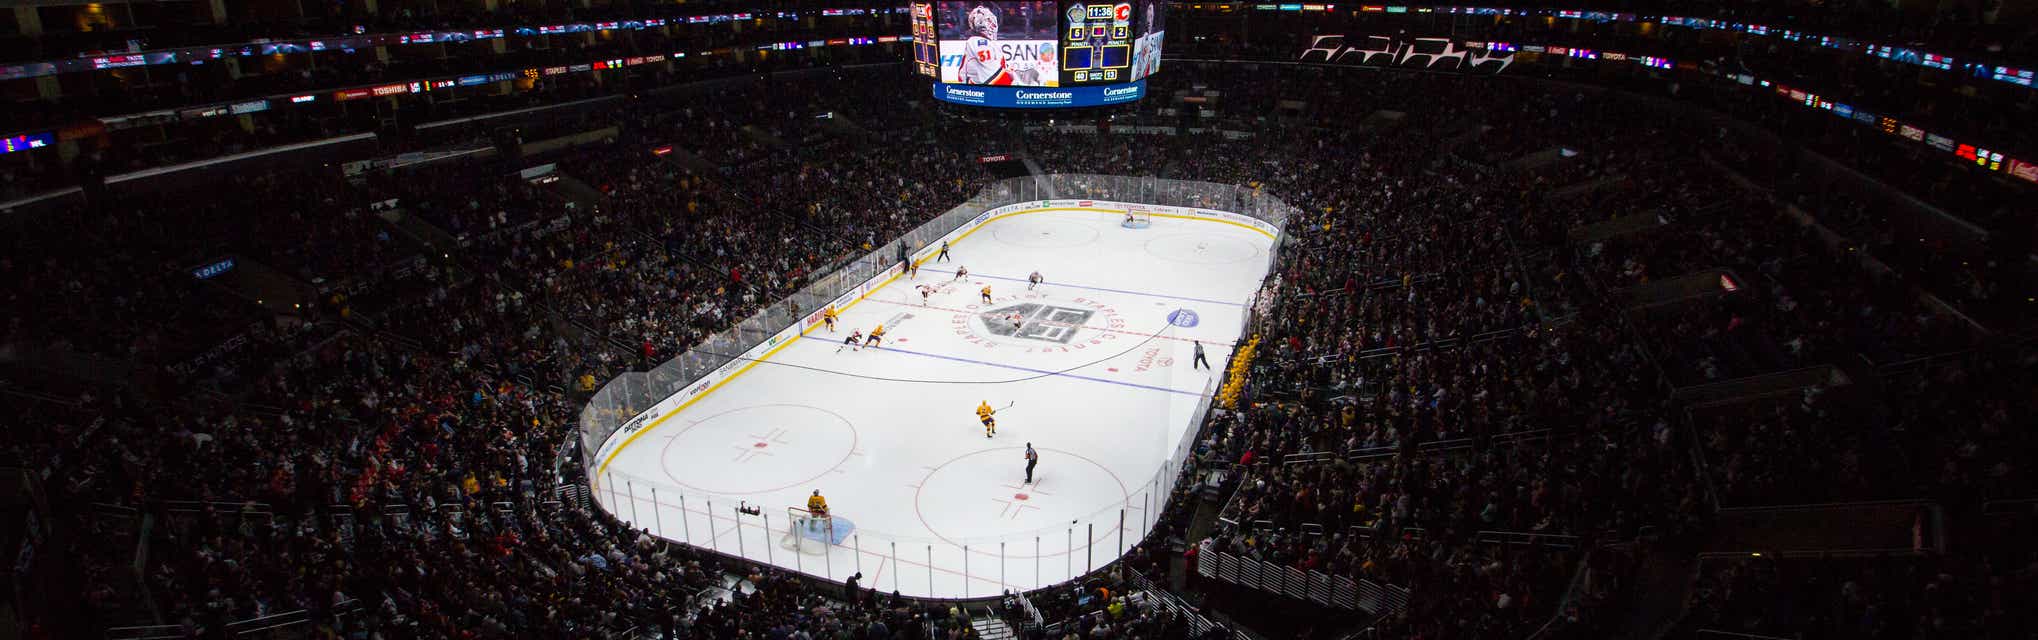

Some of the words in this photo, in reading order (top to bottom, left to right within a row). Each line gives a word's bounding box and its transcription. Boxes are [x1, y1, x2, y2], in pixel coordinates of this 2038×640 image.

[1002, 44, 1038, 61] SAN
[373, 84, 408, 95] TOSHIBA
[946, 85, 985, 98] Cornerstone
[1015, 90, 1073, 100] Cornerstone
[1103, 85, 1139, 97] Cornerstone
[203, 259, 233, 276] DELTA
[689, 380, 711, 395] verizon
[624, 412, 649, 434] DAYTONA
